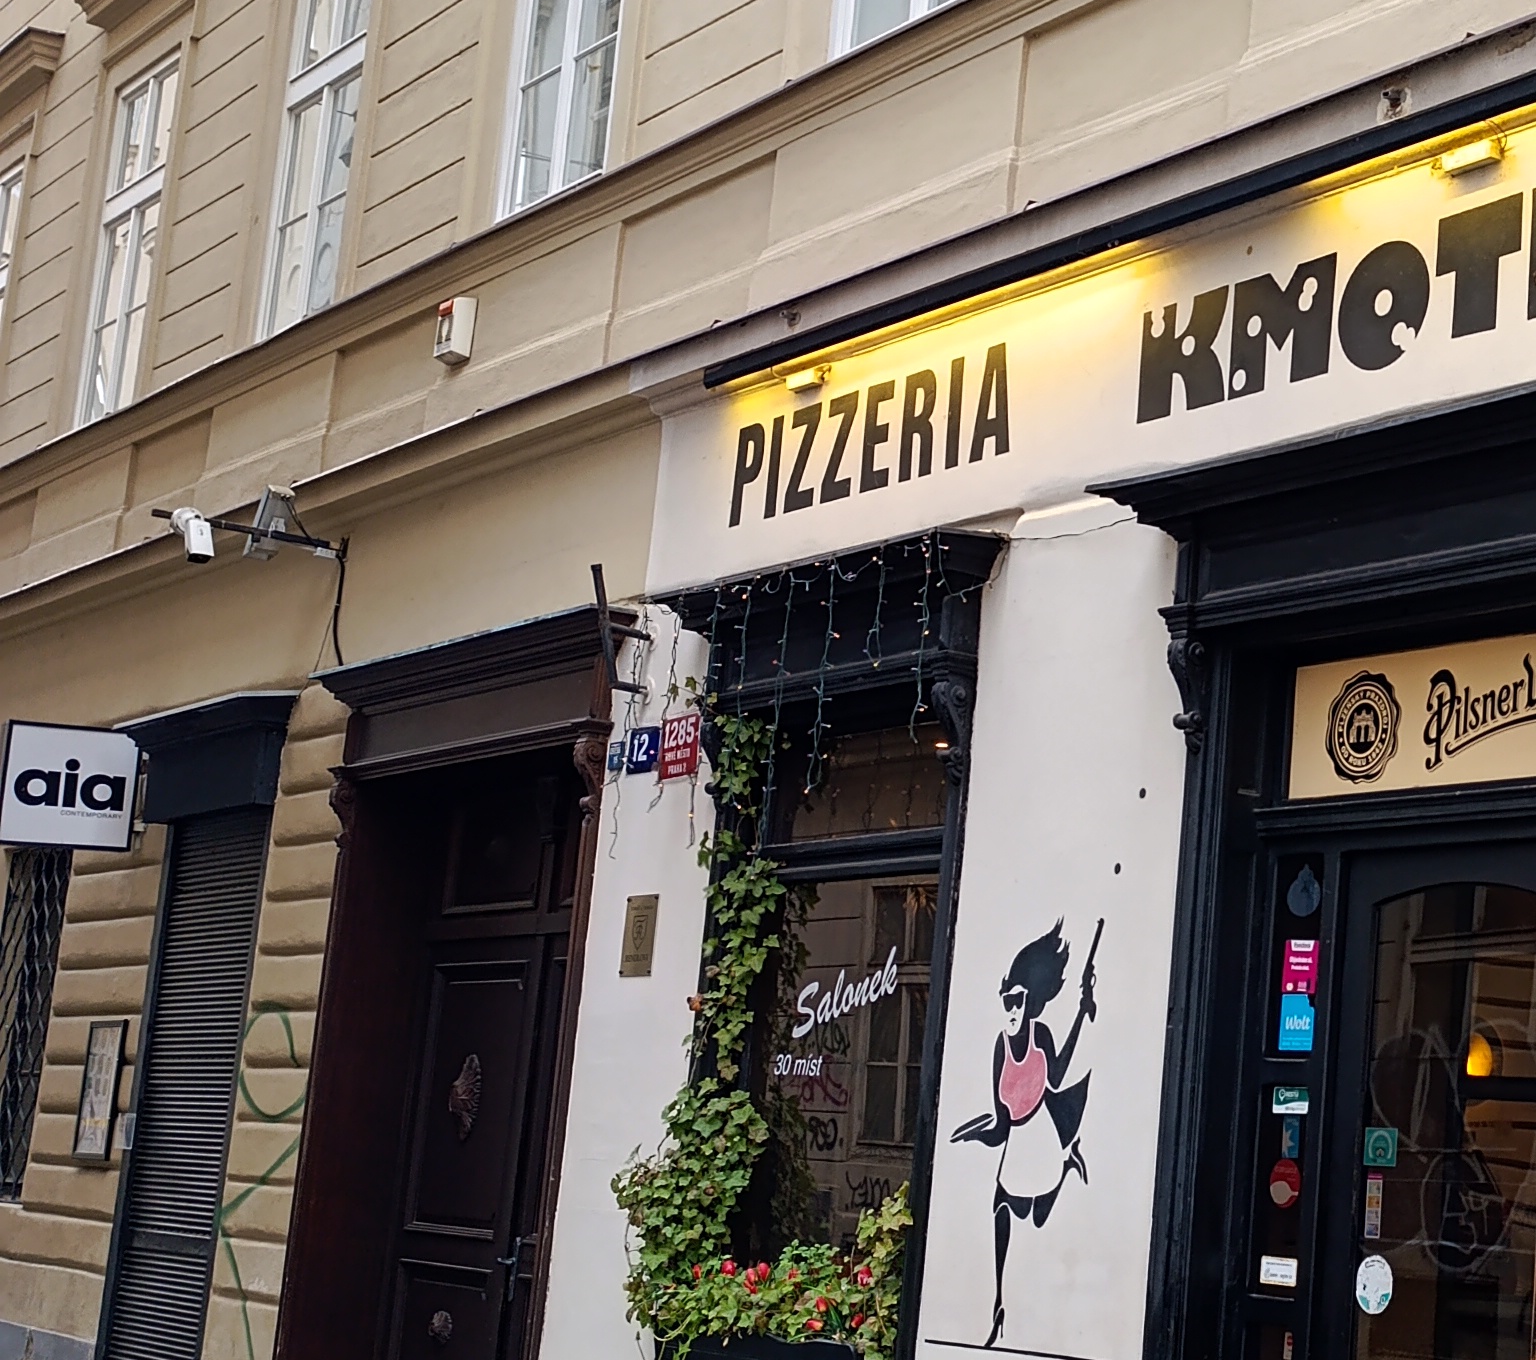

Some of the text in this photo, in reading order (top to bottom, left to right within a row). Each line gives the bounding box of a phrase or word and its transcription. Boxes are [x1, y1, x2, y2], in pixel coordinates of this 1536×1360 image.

[728, 342, 1010, 527] PIZZERIA
[664, 716, 697, 749] 1285
[1423, 669, 1525, 771] Pilsner
[632, 733, 650, 762] 12
[14, 758, 127, 811] aia
[60, 810, 122, 819] CONTEMPORARY
[792, 946, 899, 1038] Salonek
[1285, 1015, 1311, 1030] Wolt
[774, 1053, 823, 1077] 30 míst
